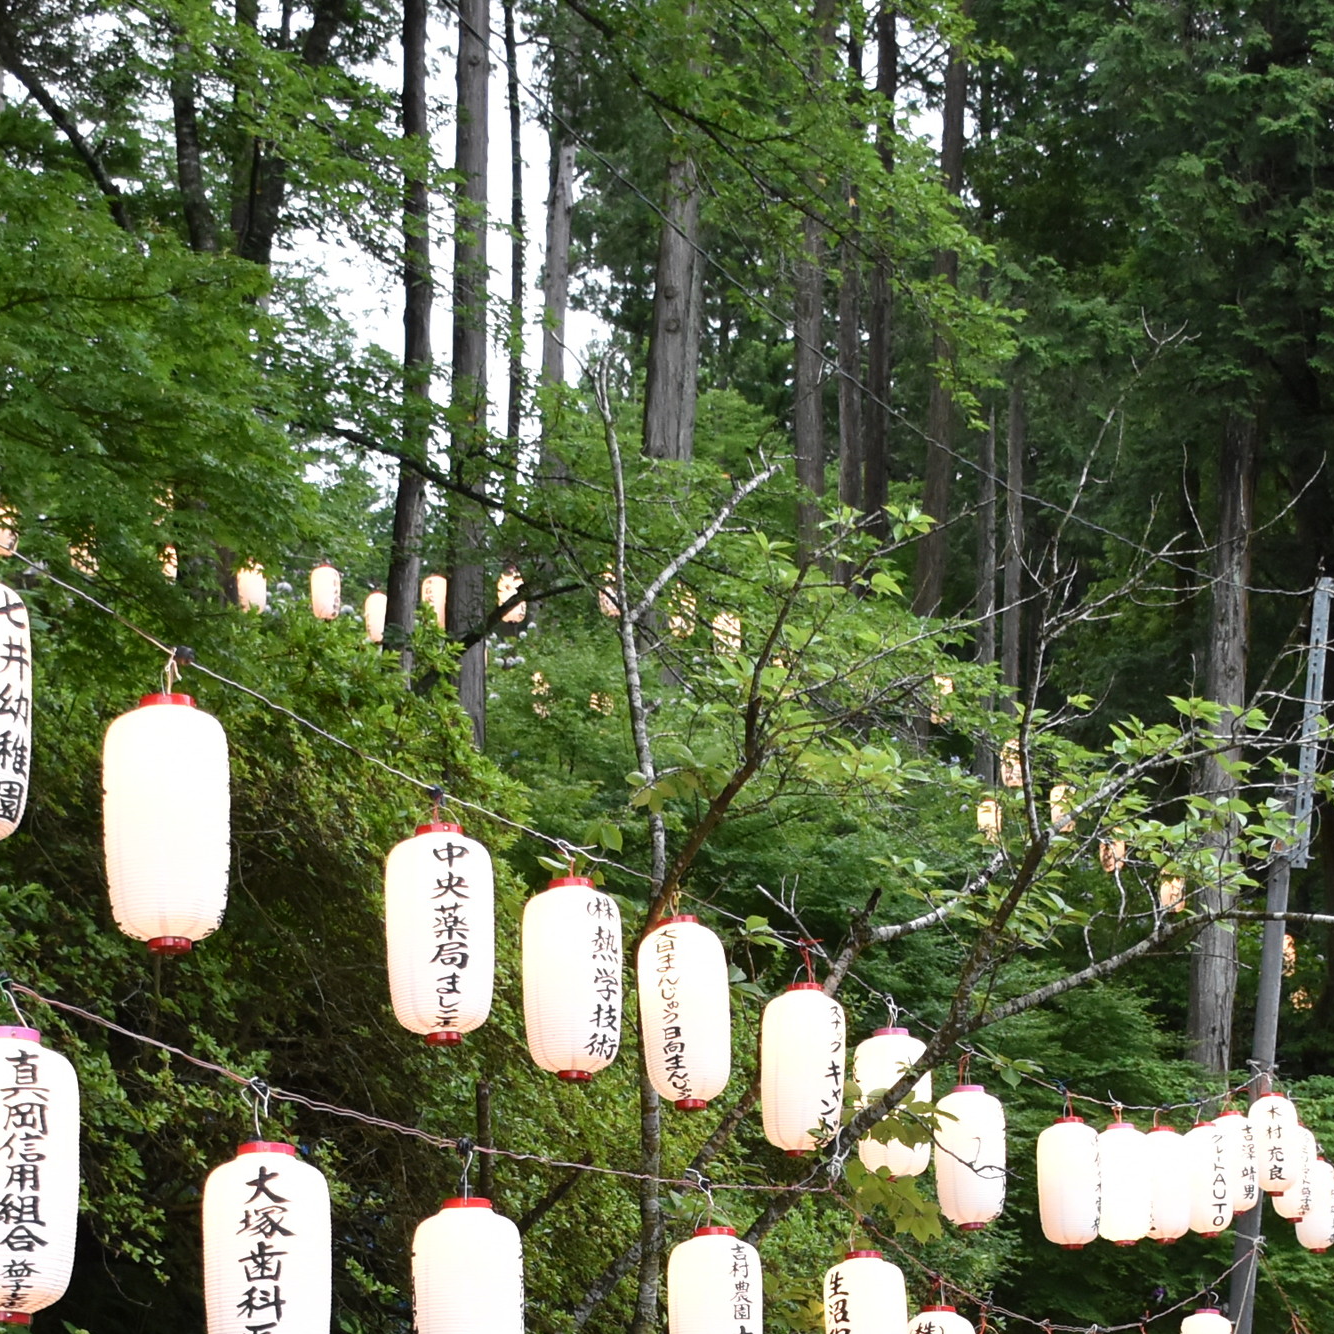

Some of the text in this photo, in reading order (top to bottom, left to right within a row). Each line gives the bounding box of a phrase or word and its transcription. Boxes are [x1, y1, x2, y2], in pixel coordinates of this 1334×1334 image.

[817, 1006, 843, 1142] スナックキャンド
[1267, 1104, 1287, 1181] 木村充良
